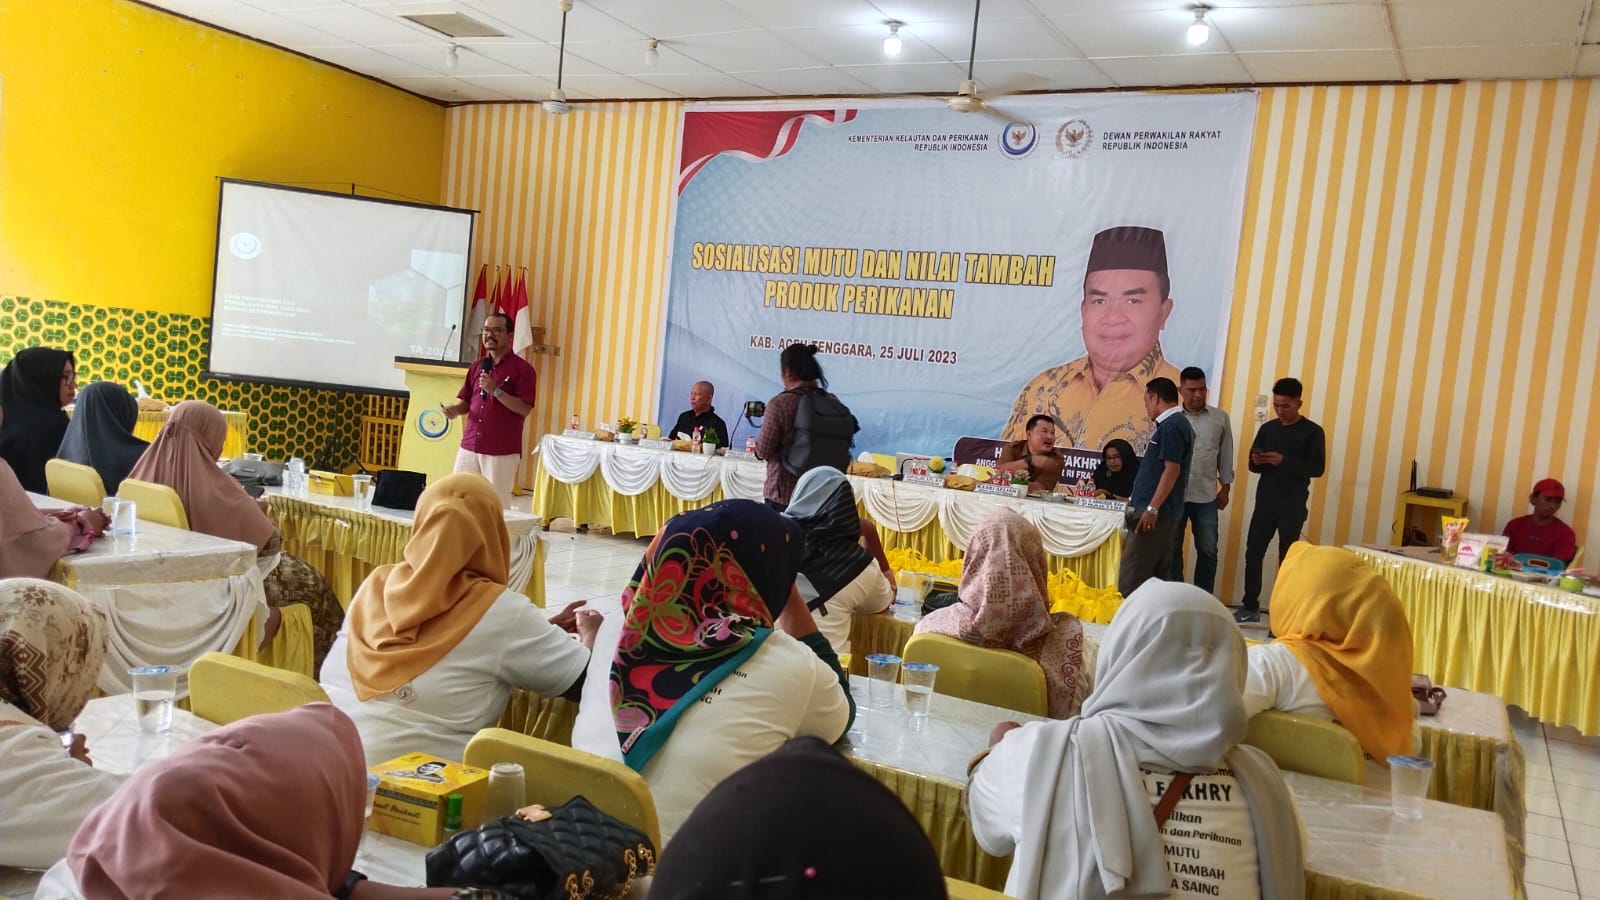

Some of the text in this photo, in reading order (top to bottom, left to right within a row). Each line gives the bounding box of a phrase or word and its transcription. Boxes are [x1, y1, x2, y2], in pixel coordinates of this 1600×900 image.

[848, 133, 989, 143] KEMENTERIAN KELAUTAN DAN PERIKANAN
[1103, 130, 1222, 140] DEWAN PERWAKILAN RAKYAT
[914, 143, 988, 152] REPUBLIK INDONESIA
[1102, 141, 1188, 150] REPUBLIK INDONESIA
[692, 241, 1056, 287] SOSIALISASI MUTU DAN NILAI TAMBAH
[764, 280, 955, 319] PRODUK PERIKANAN
[411, 345, 423, 354] TA
[750, 335, 774, 349] KAB.
[879, 345, 894, 359] 25
[897, 347, 924, 361] JULI
[928, 350, 957, 364] 2023
[976, 458, 997, 468] ANGG
[1066, 470, 1075, 478] RI
[1076, 471, 1094, 480] FRA
[1156, 781, 1232, 802] FKHRY
[1169, 828, 1191, 838] dan
[1192, 829, 1242, 846] Perikanan
[1163, 844, 1200, 860] MUTU
[1173, 862, 1225, 880] TAMBAH
[1181, 880, 1220, 897] SAING
